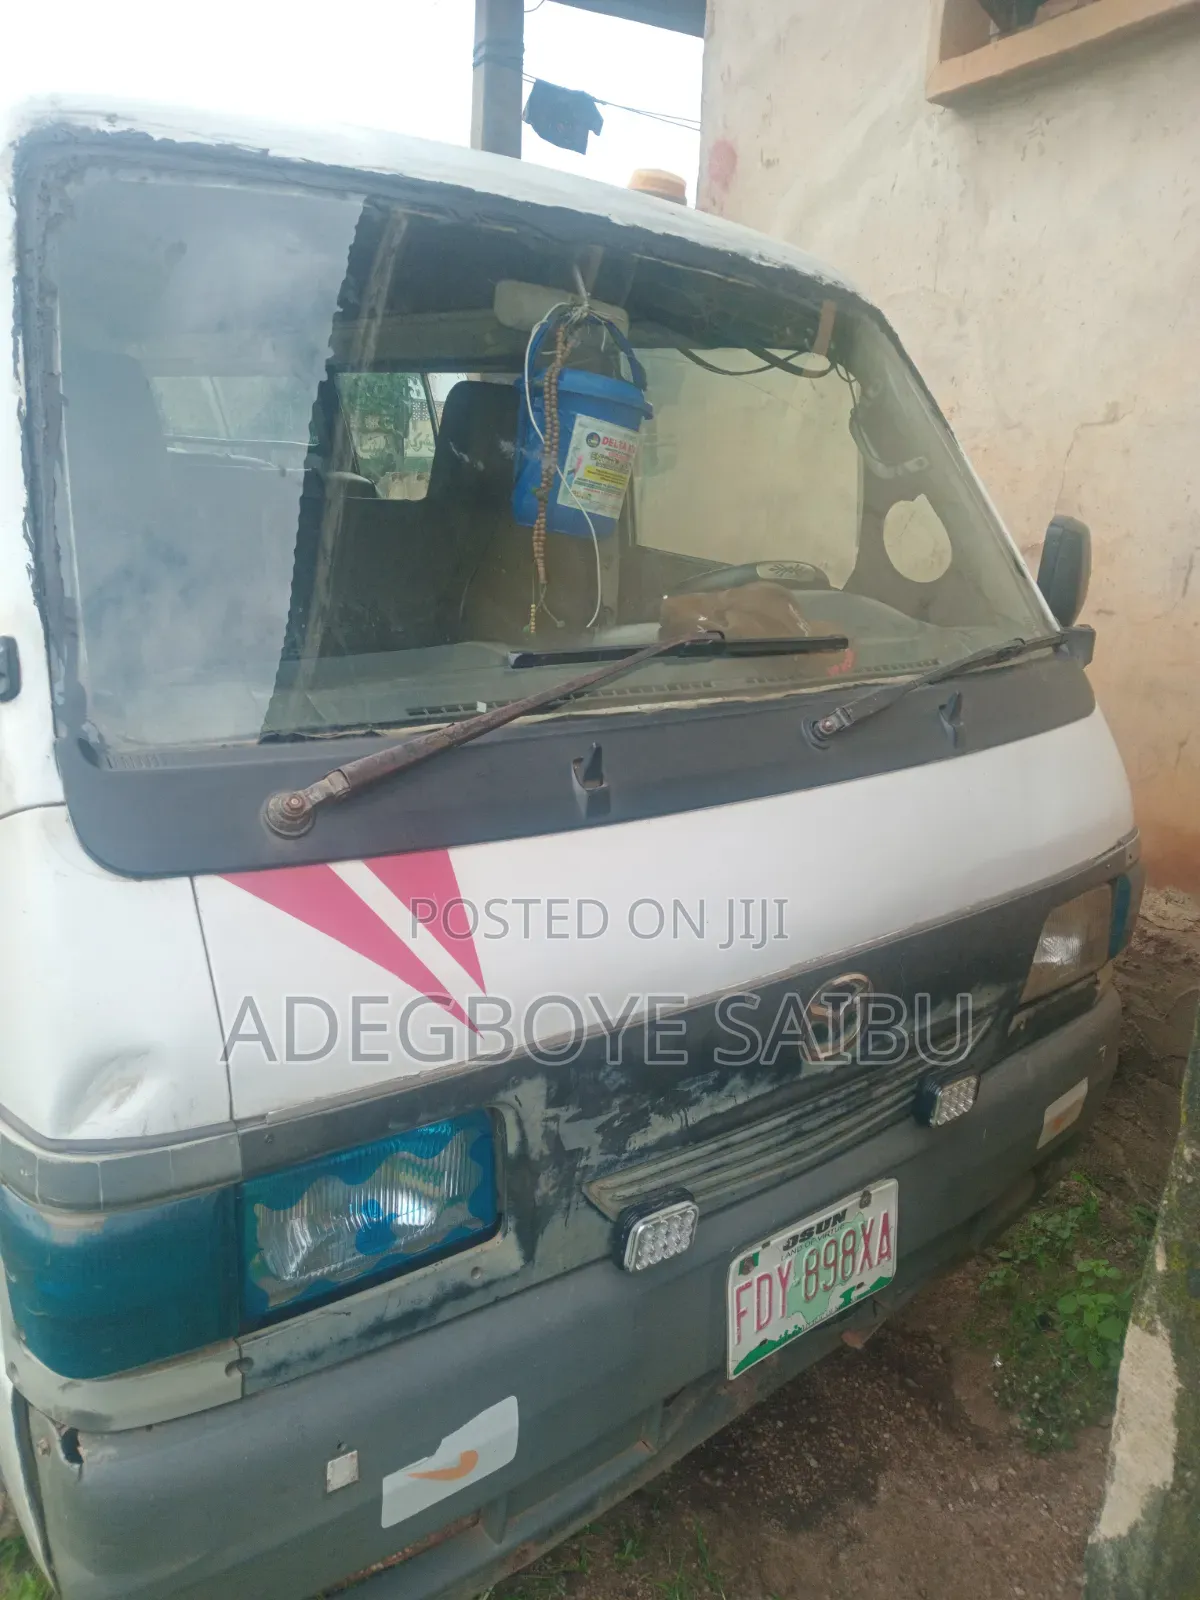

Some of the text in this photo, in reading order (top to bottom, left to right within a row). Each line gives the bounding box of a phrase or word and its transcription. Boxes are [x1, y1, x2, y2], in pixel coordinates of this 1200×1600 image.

[781, 1243, 803, 1261] LAND
[818, 1224, 845, 1242] VIRTUE
[783, 1209, 847, 1251] OSUN
[735, 1211, 892, 1345] FDY 898XA
